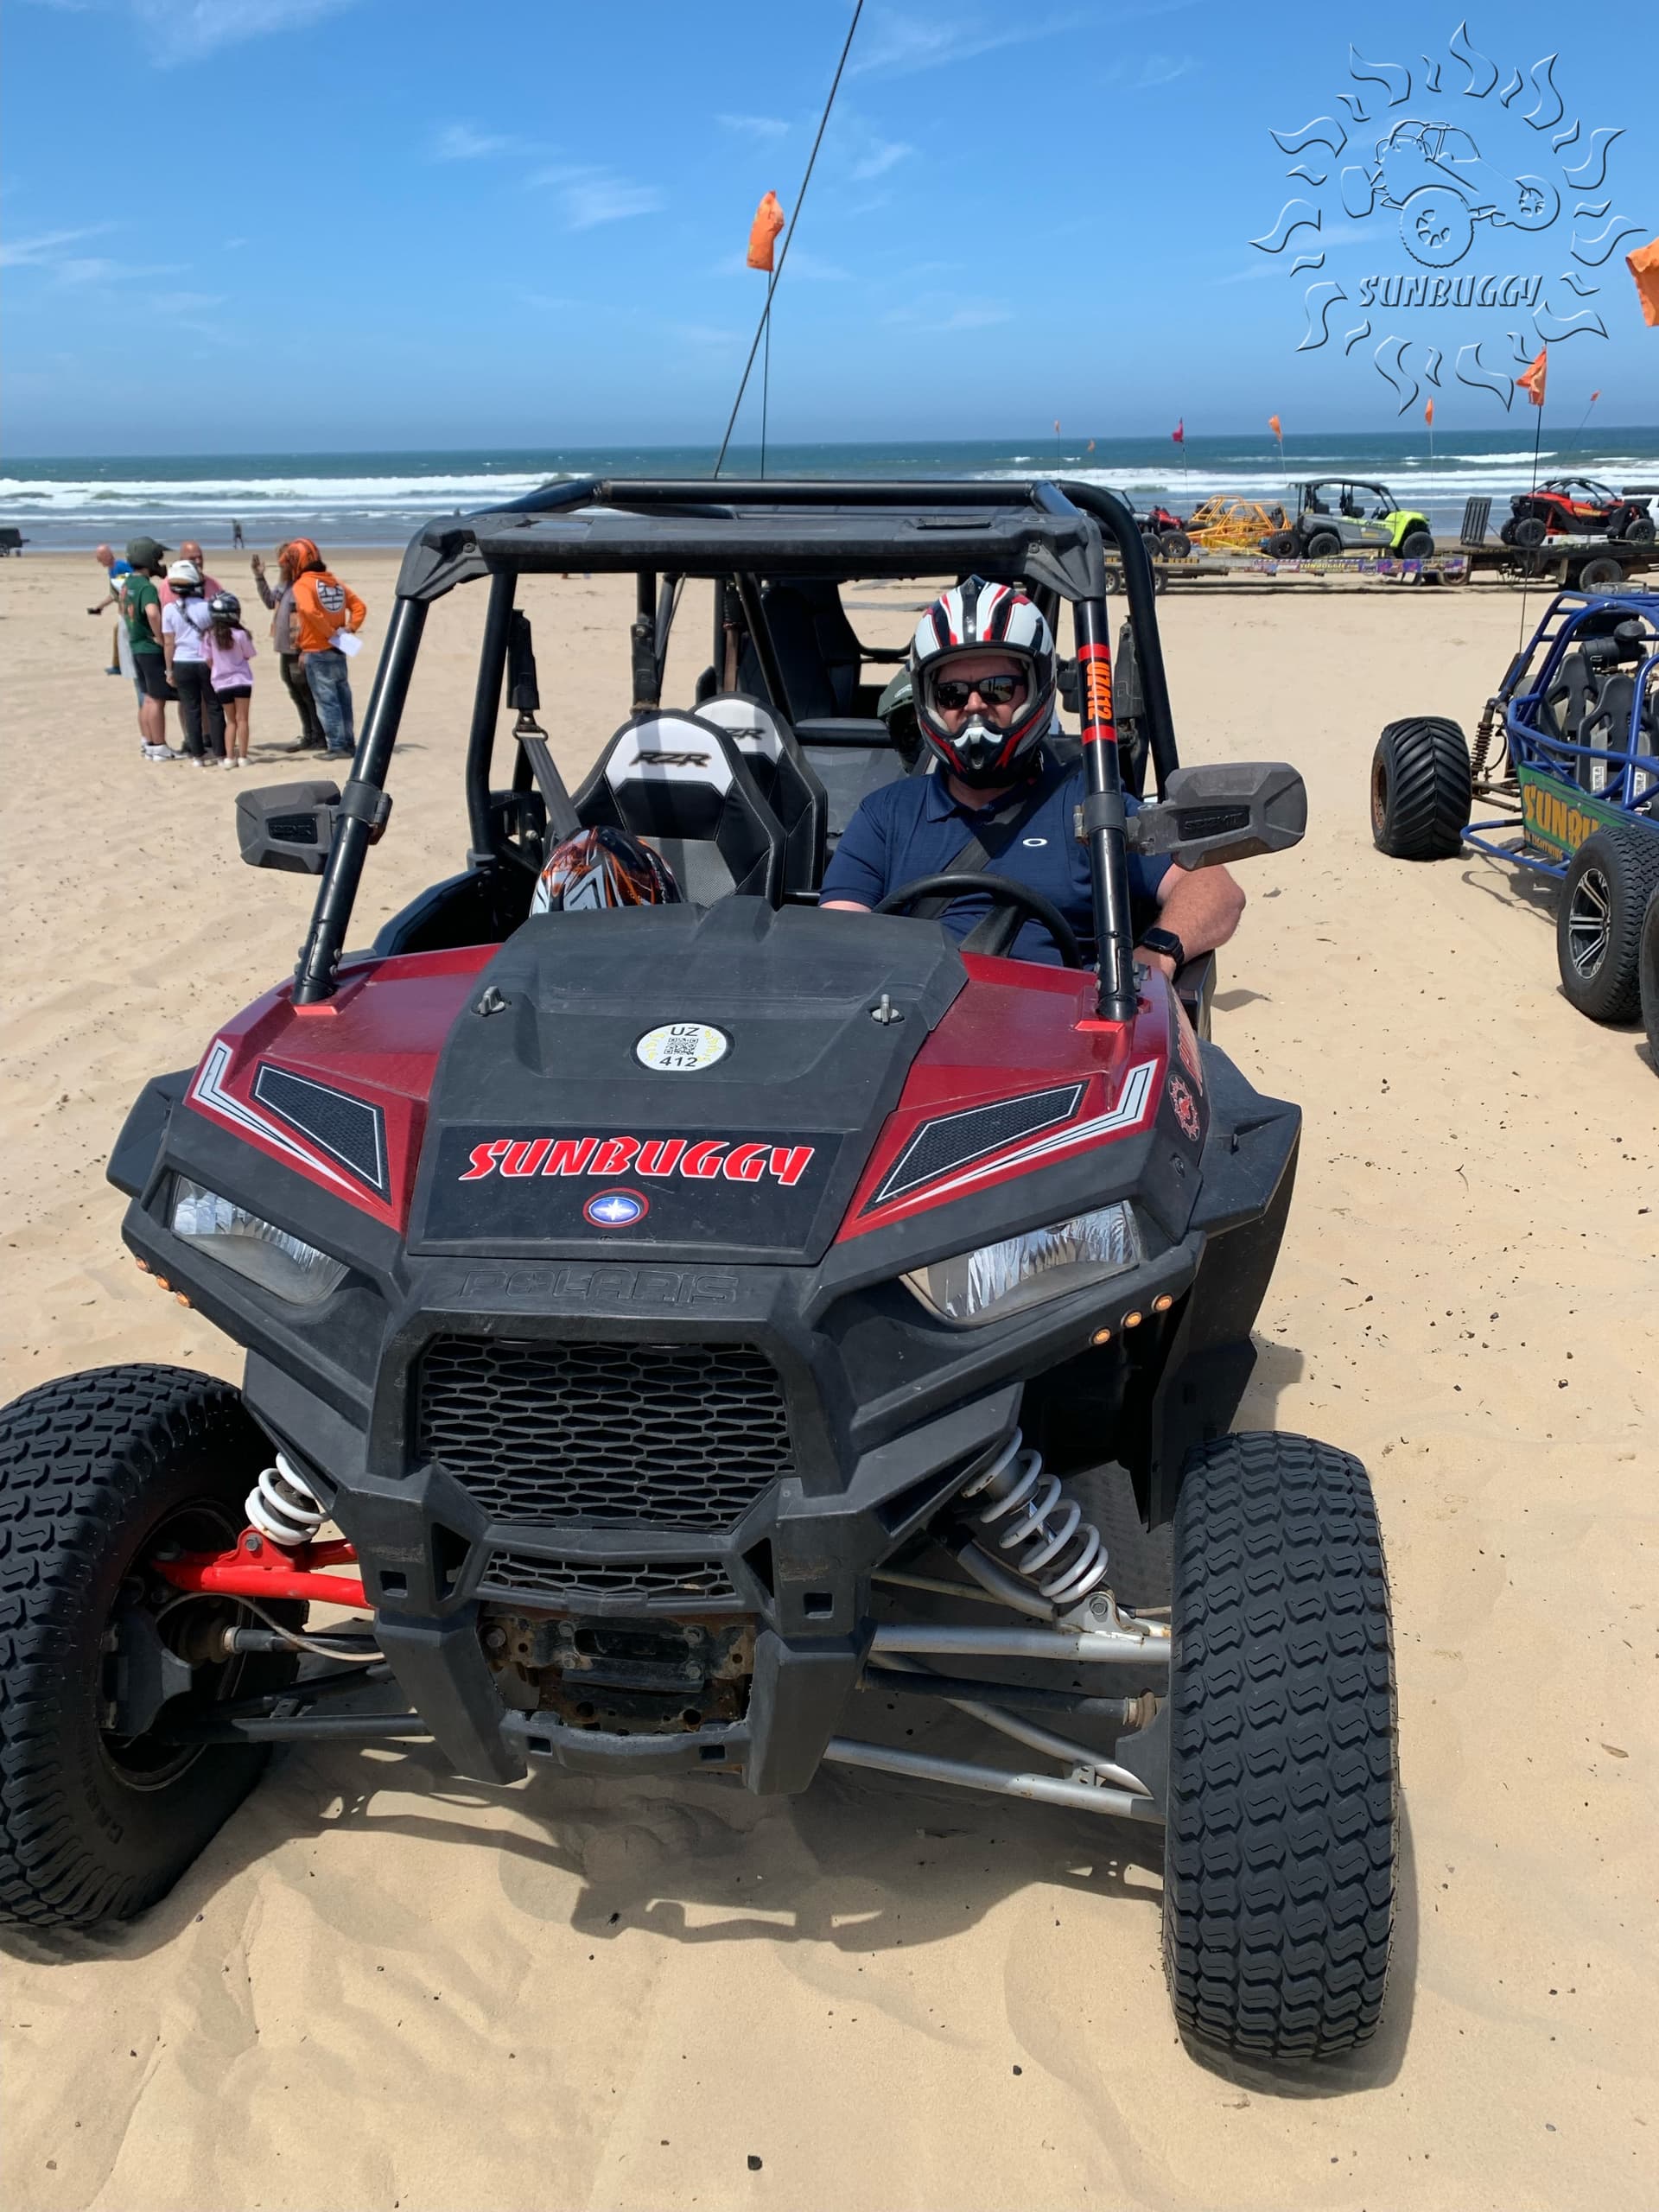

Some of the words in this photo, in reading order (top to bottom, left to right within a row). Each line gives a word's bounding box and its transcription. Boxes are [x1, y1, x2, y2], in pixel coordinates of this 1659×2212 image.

[1086, 661, 1113, 721] UZ412
[722, 727, 766, 741] ZR
[629, 750, 712, 768] RZR
[670, 1026, 701, 1037] UZ
[659, 1056, 698, 1067] 412
[457, 1135, 816, 1186] SUNBUGGY
[458, 1267, 740, 1304] POLARIS
